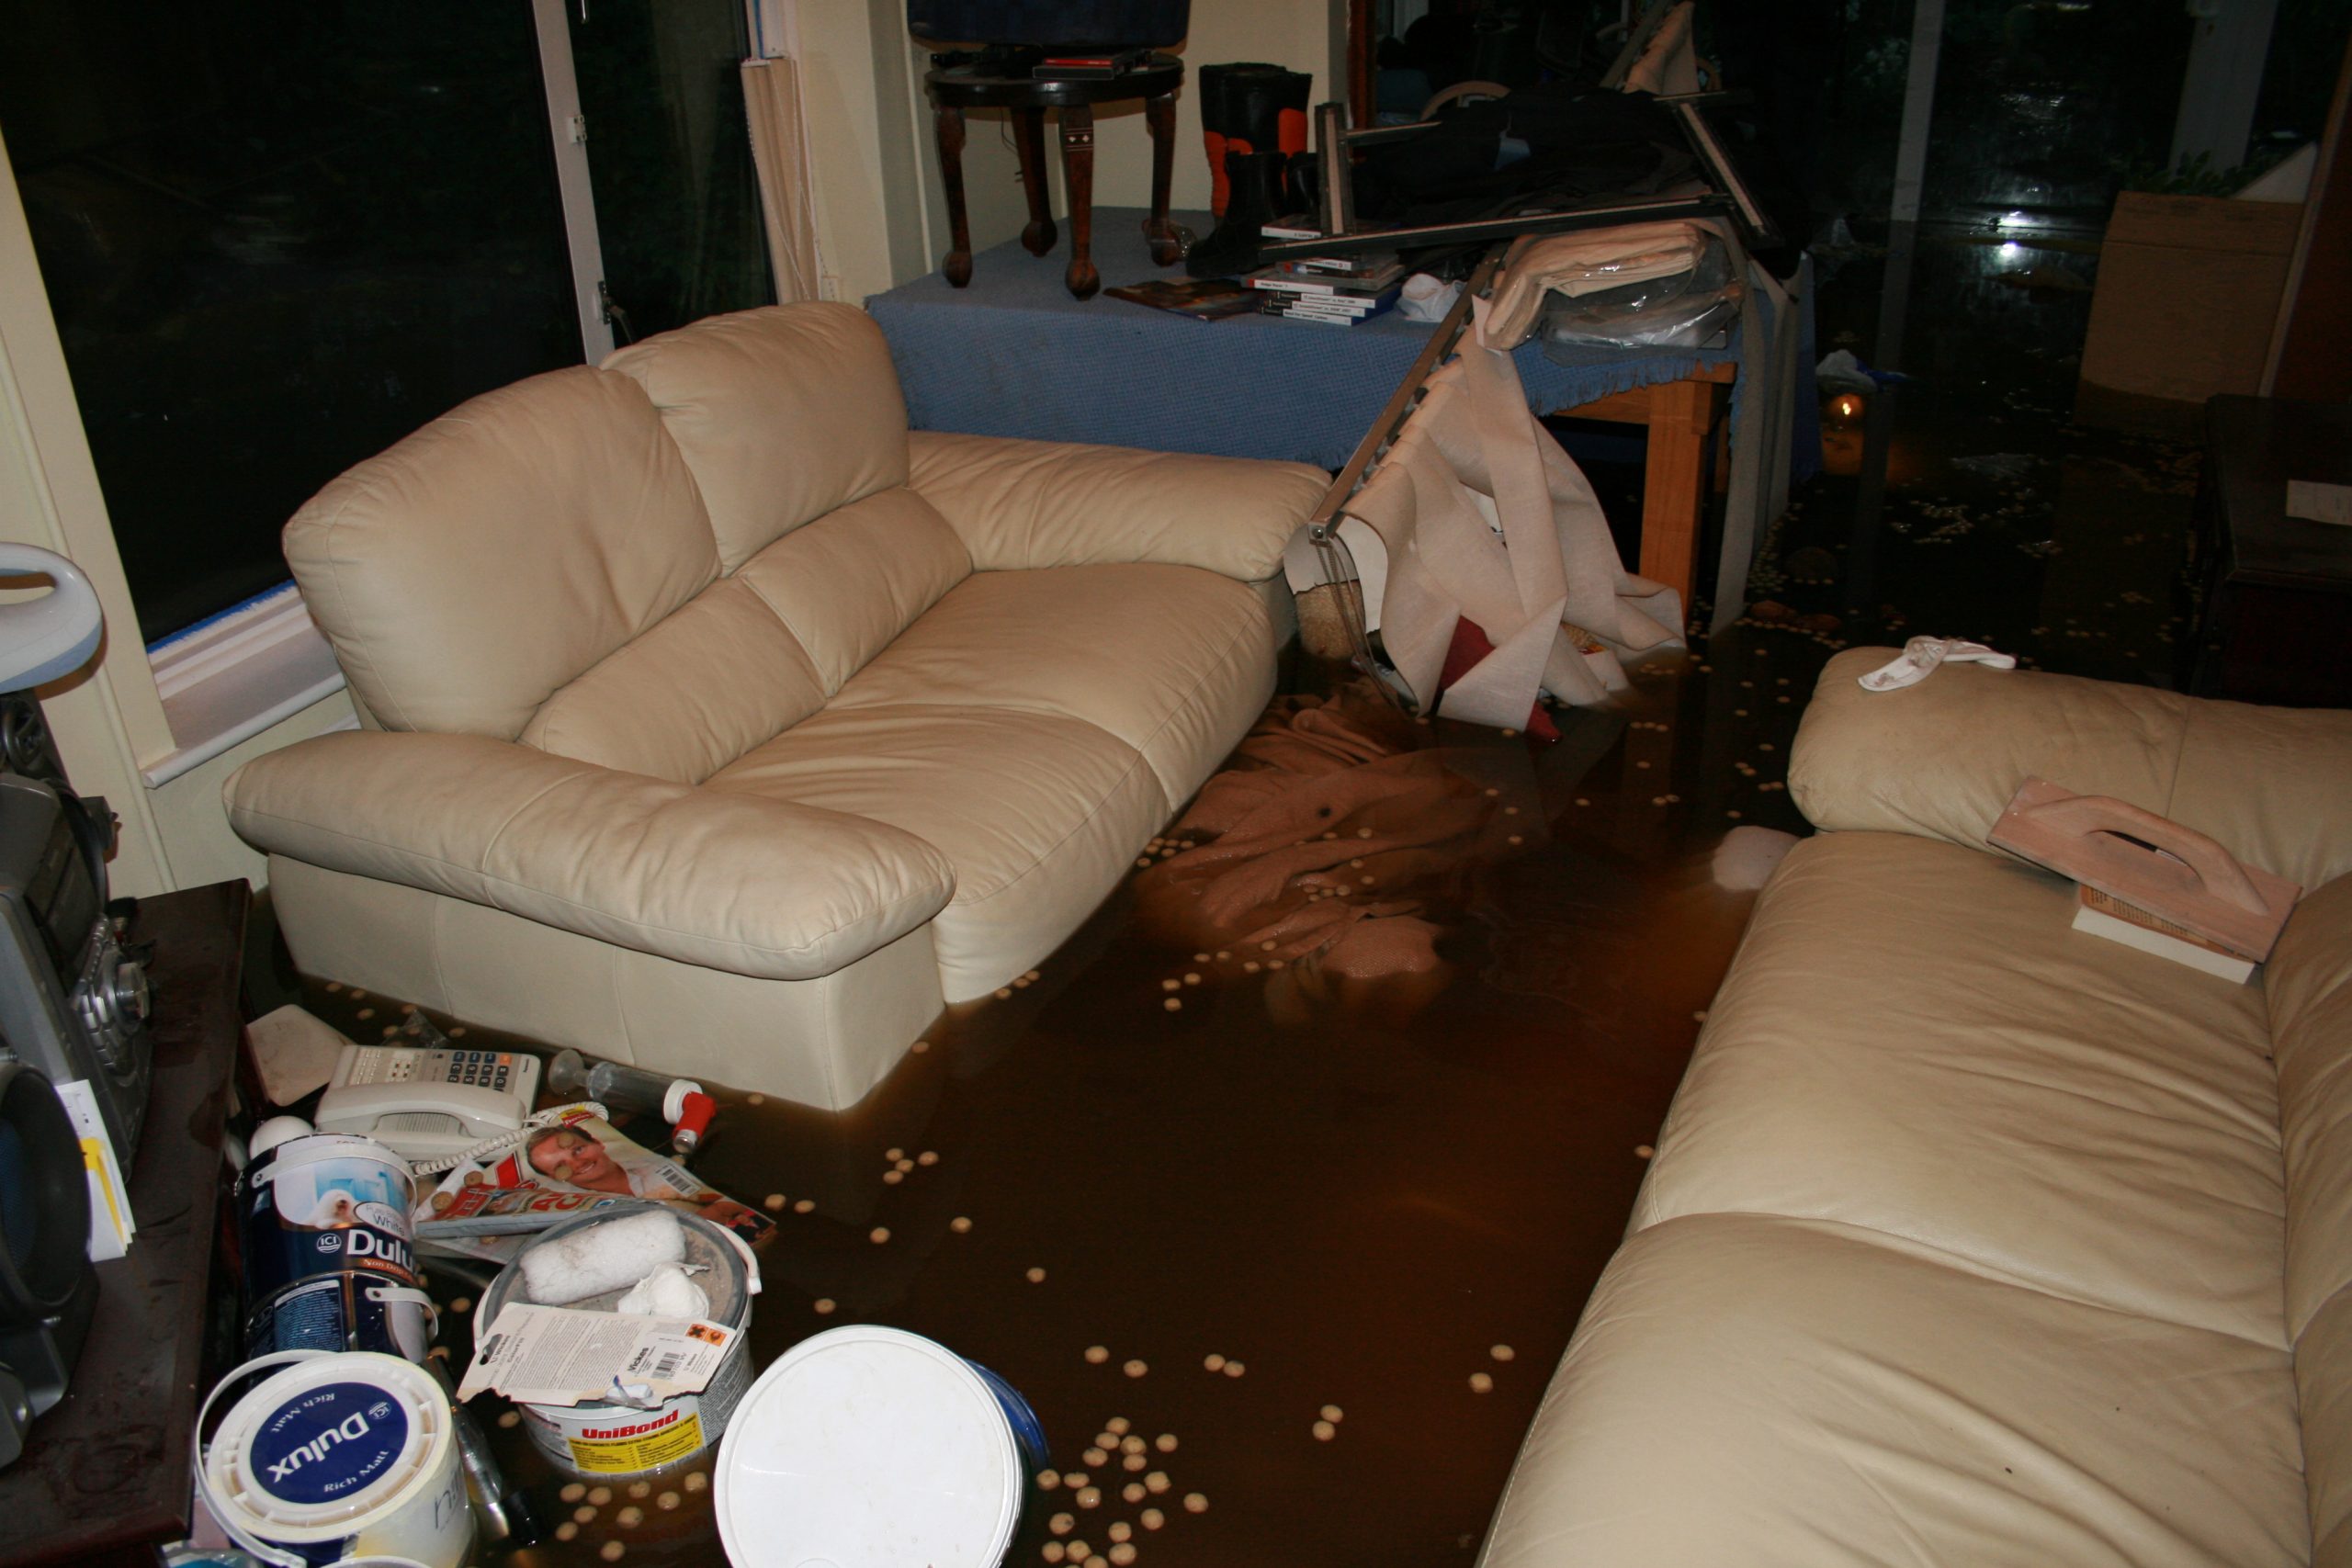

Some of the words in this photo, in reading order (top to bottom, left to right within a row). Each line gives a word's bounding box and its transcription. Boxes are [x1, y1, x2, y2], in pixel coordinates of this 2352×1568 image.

[373, 1213, 405, 1236] White
[321, 1235, 337, 1246] ICI
[347, 1229, 414, 1273] Dulu
[302, 1393, 335, 1407] Rich
[373, 1405, 390, 1419] ICI
[271, 1407, 301, 1433] Matt
[582, 1409, 679, 1439] UniBond
[266, 1411, 370, 1483] Dulux
[323, 1477, 357, 1493] Rich
[359, 1450, 390, 1475] Matt
